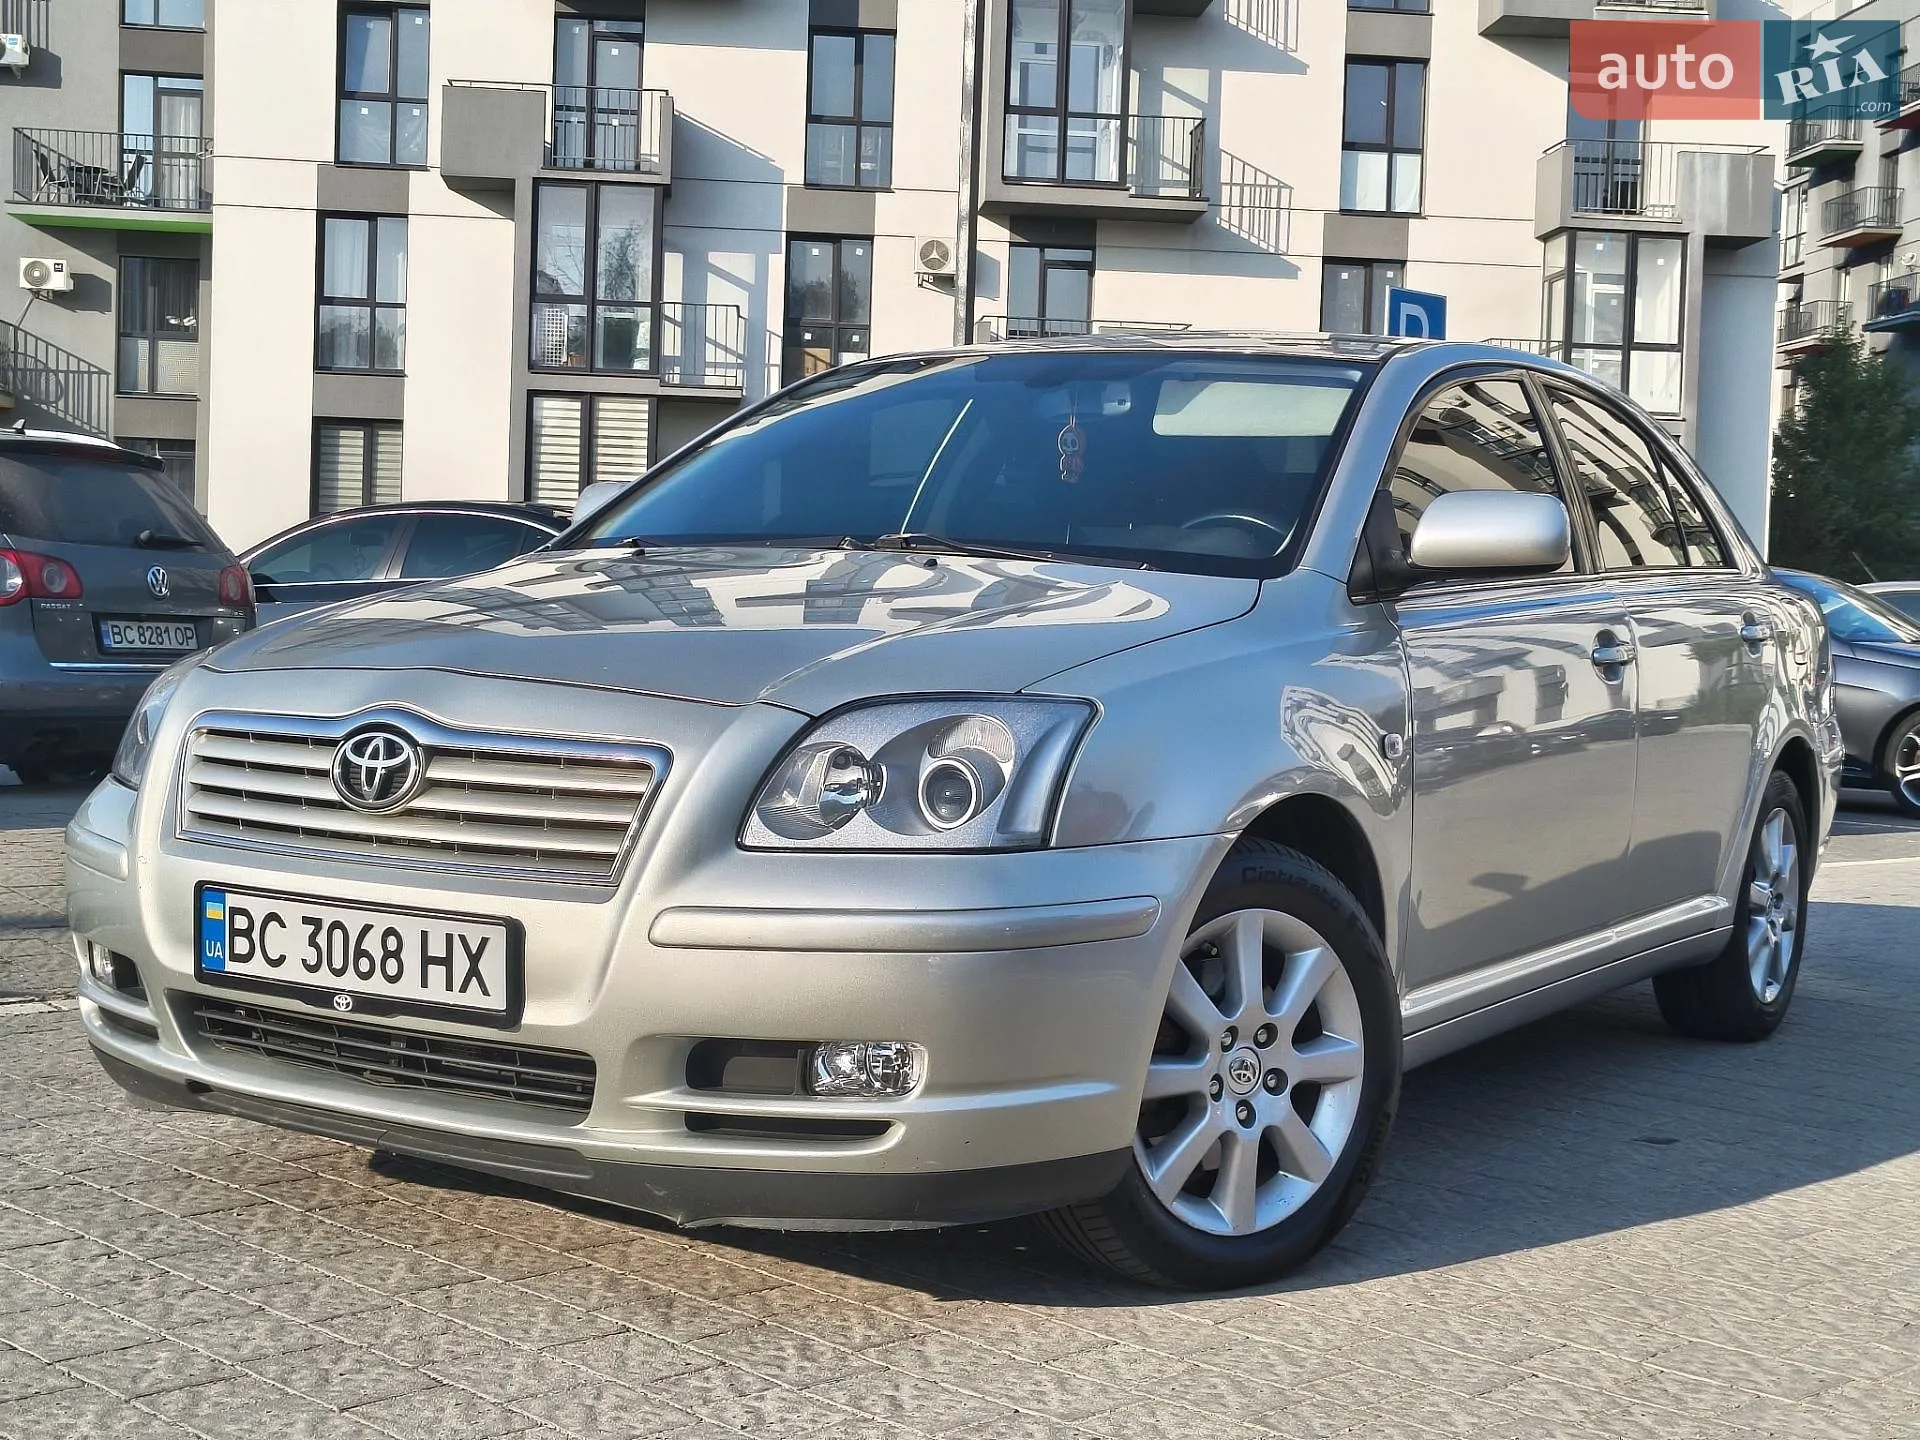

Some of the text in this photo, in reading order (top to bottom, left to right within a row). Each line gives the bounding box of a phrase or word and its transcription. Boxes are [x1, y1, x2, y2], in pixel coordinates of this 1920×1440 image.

[110, 624, 195, 647] BC 8281 OP
[205, 939, 224, 959] UA
[228, 905, 491, 998] BC 3068 HX
